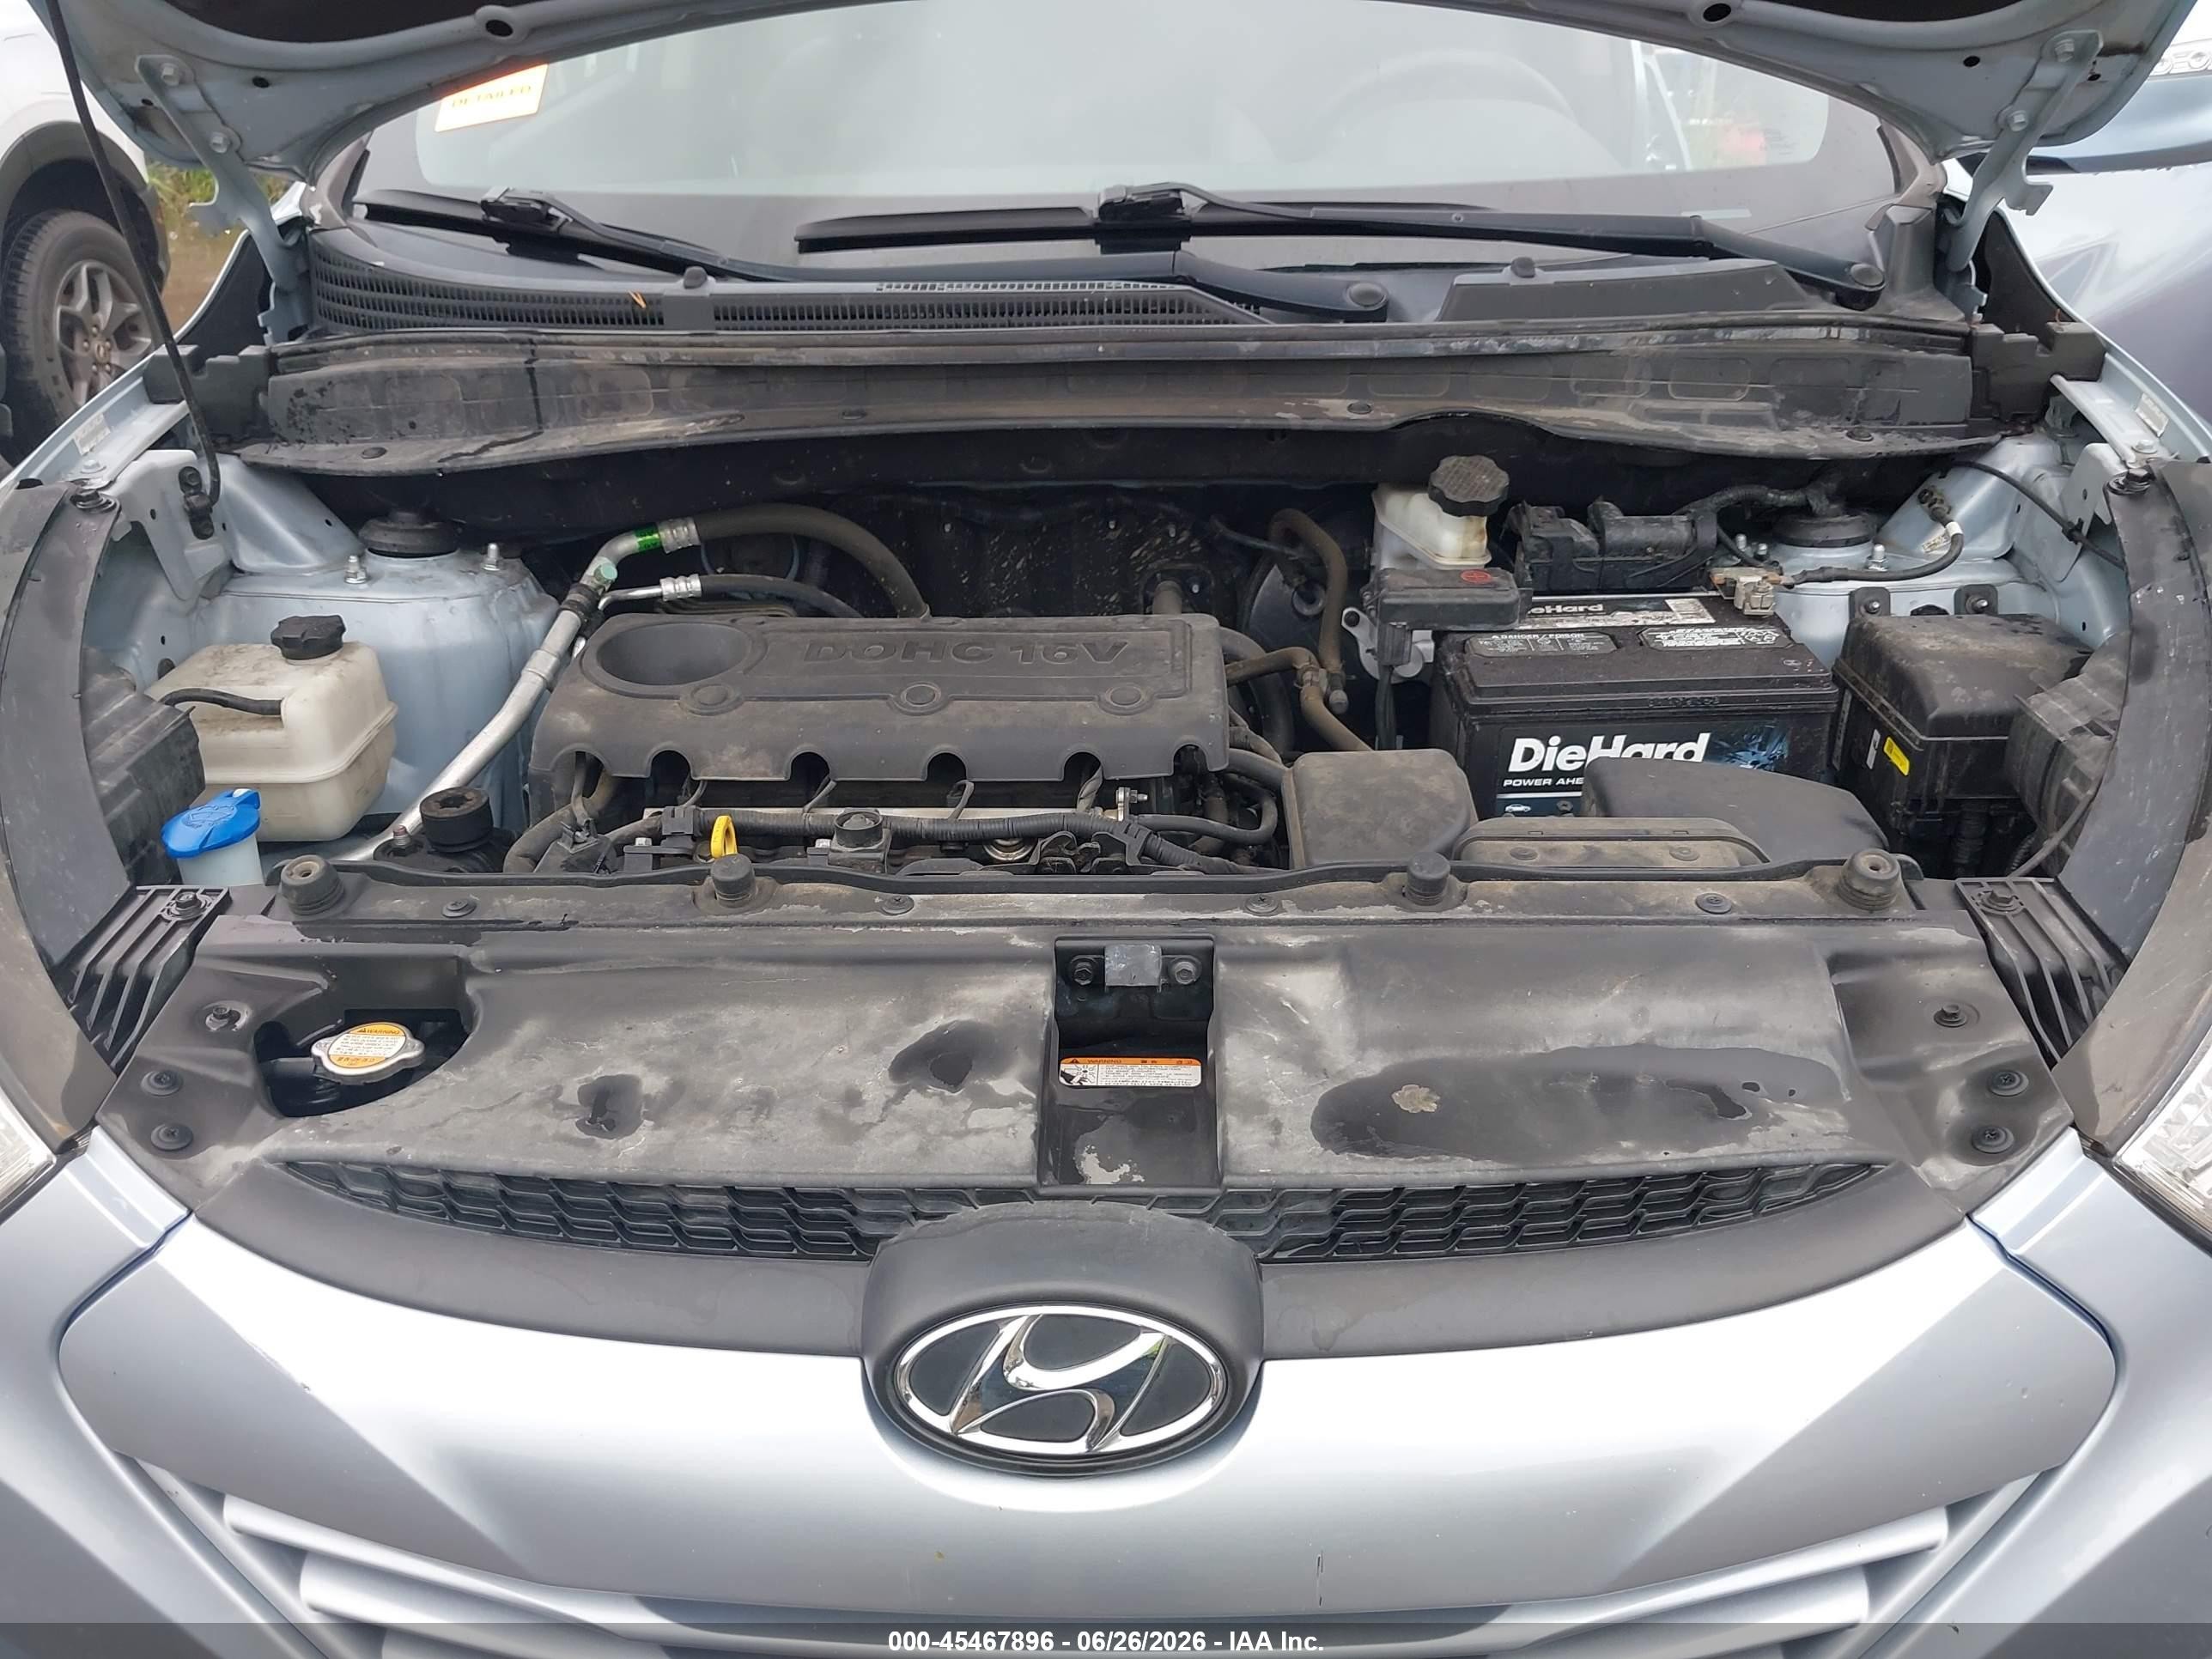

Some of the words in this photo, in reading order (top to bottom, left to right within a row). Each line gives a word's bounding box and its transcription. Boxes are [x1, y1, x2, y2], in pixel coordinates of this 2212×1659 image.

[1528, 604, 1604, 615] eHard
[803, 641, 994, 664] DOHC
[1009, 641, 1128, 665] 16V
[1508, 732, 1711, 772] DieHard
[1504, 778, 1552, 787] POWER
[1556, 776, 1585, 786] AHE
